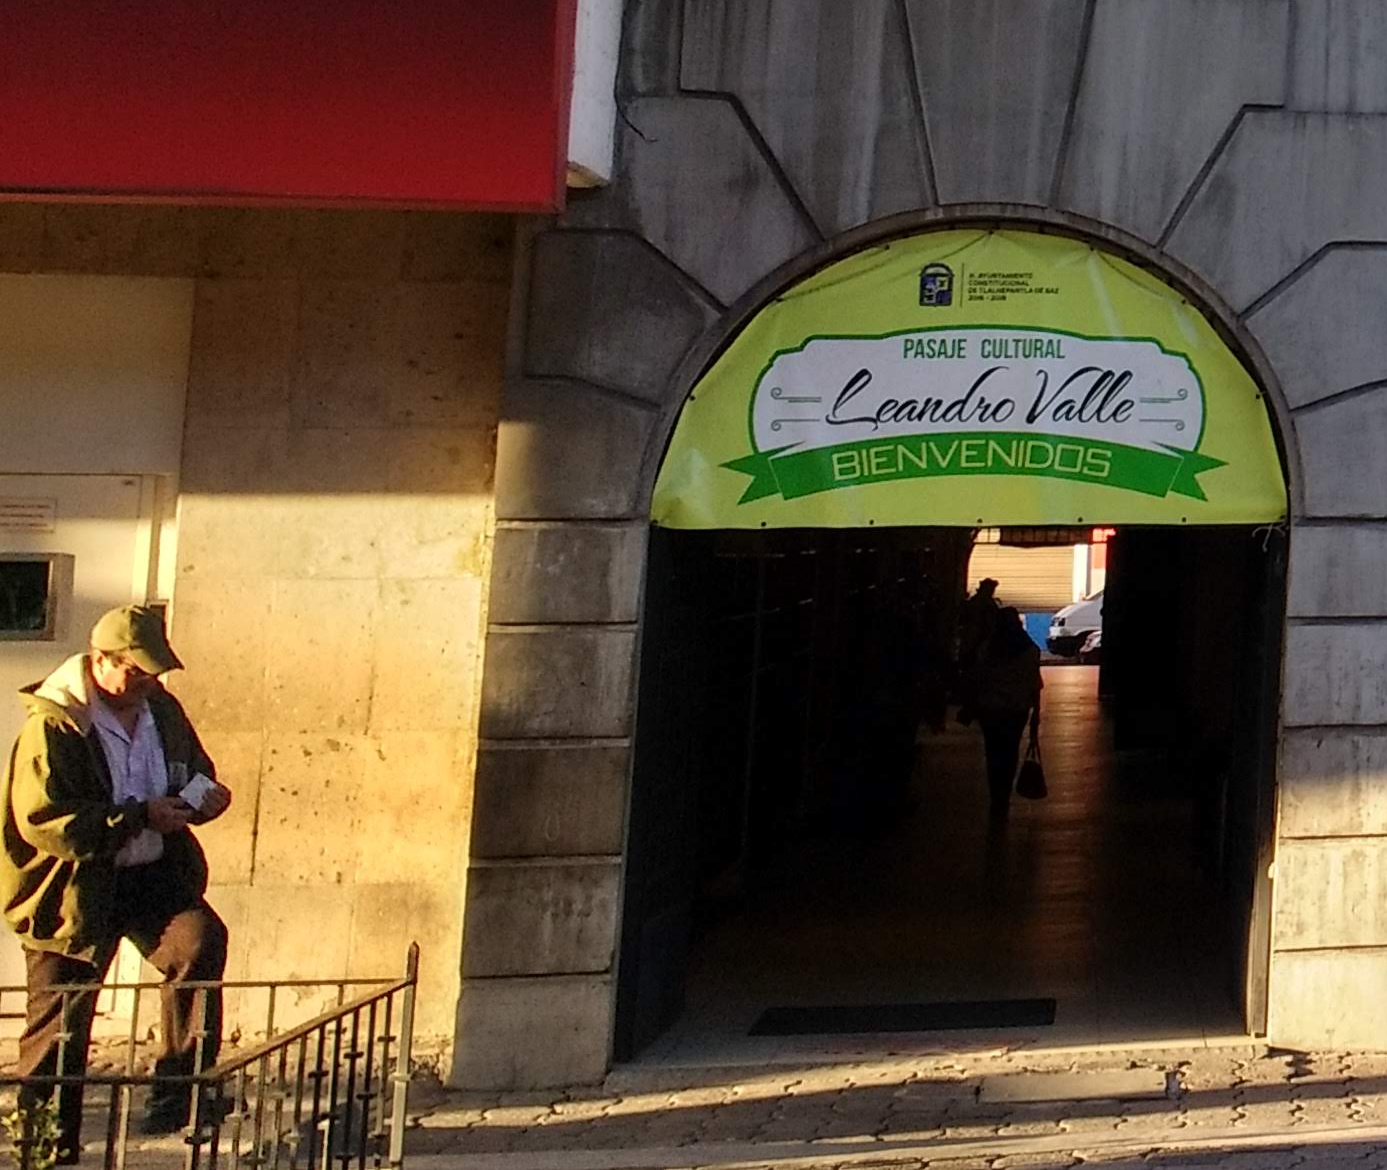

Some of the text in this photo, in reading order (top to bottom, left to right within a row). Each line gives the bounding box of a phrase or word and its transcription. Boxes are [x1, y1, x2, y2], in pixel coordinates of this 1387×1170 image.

[903, 338, 1066, 359] PASAJE CULTURAL
[826, 366, 1135, 431] Leandro Valle
[831, 440, 1113, 482] BIENVENIDOS
